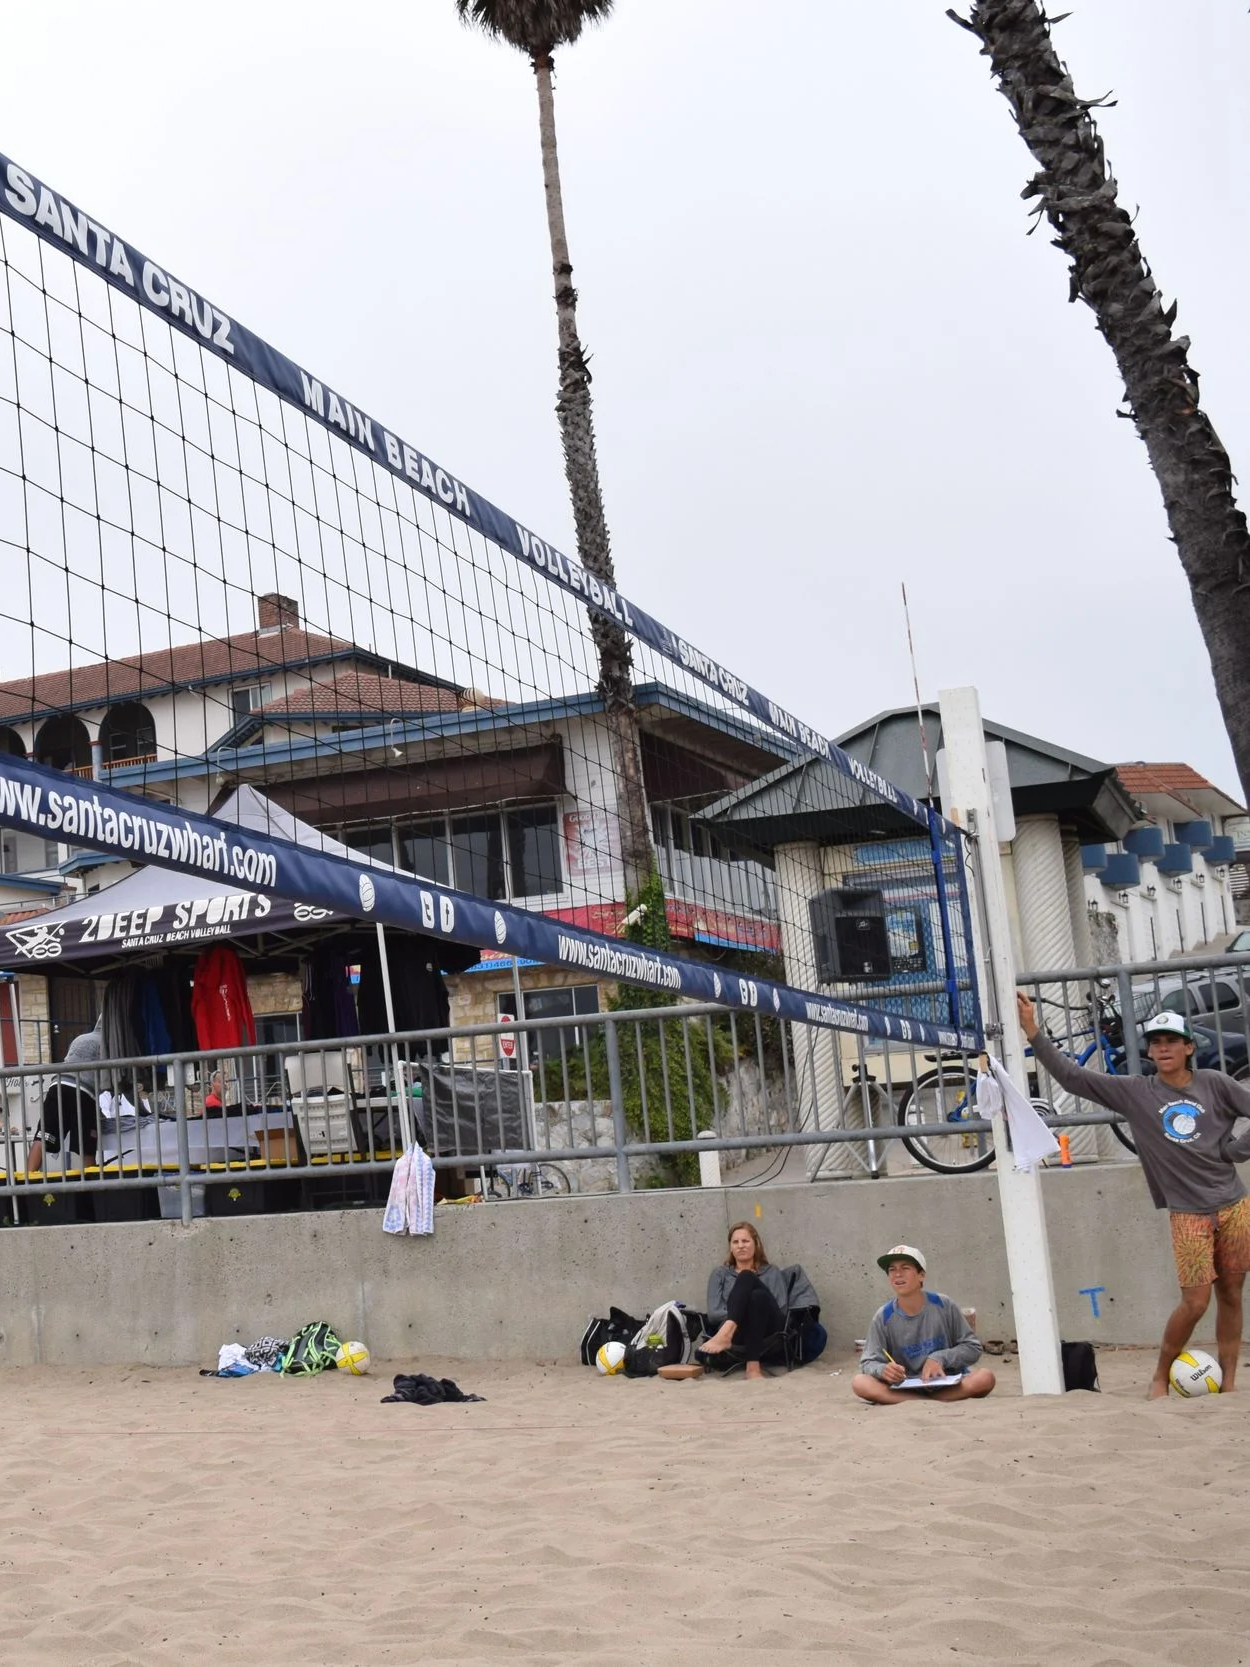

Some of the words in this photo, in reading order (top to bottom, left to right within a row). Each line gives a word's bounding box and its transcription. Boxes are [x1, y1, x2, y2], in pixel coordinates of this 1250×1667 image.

[5, 163, 134, 286] SANTA
[143, 260, 234, 354] CRUZ
[301, 370, 375, 451] MAIN
[383, 430, 471, 516] BEACH
[515, 523, 633, 626] VOLLEYBALL
[678, 639, 719, 686] SANTA
[718, 666, 749, 705] CRUZ
[767, 700, 797, 737] MAIN
[847, 755, 898, 804] VOLLEYBALL
[173, 892, 271, 928] SPORTS
[121, 938, 144, 949] SANTA
[144, 936, 164, 947] CRUZ
[166, 931, 189, 944] BEACH
[190, 925, 231, 940] VOLLEYBALL
[557, 933, 681, 990] www.santacruzwharf.com
[1190, 1364, 1213, 1381] Wilson
